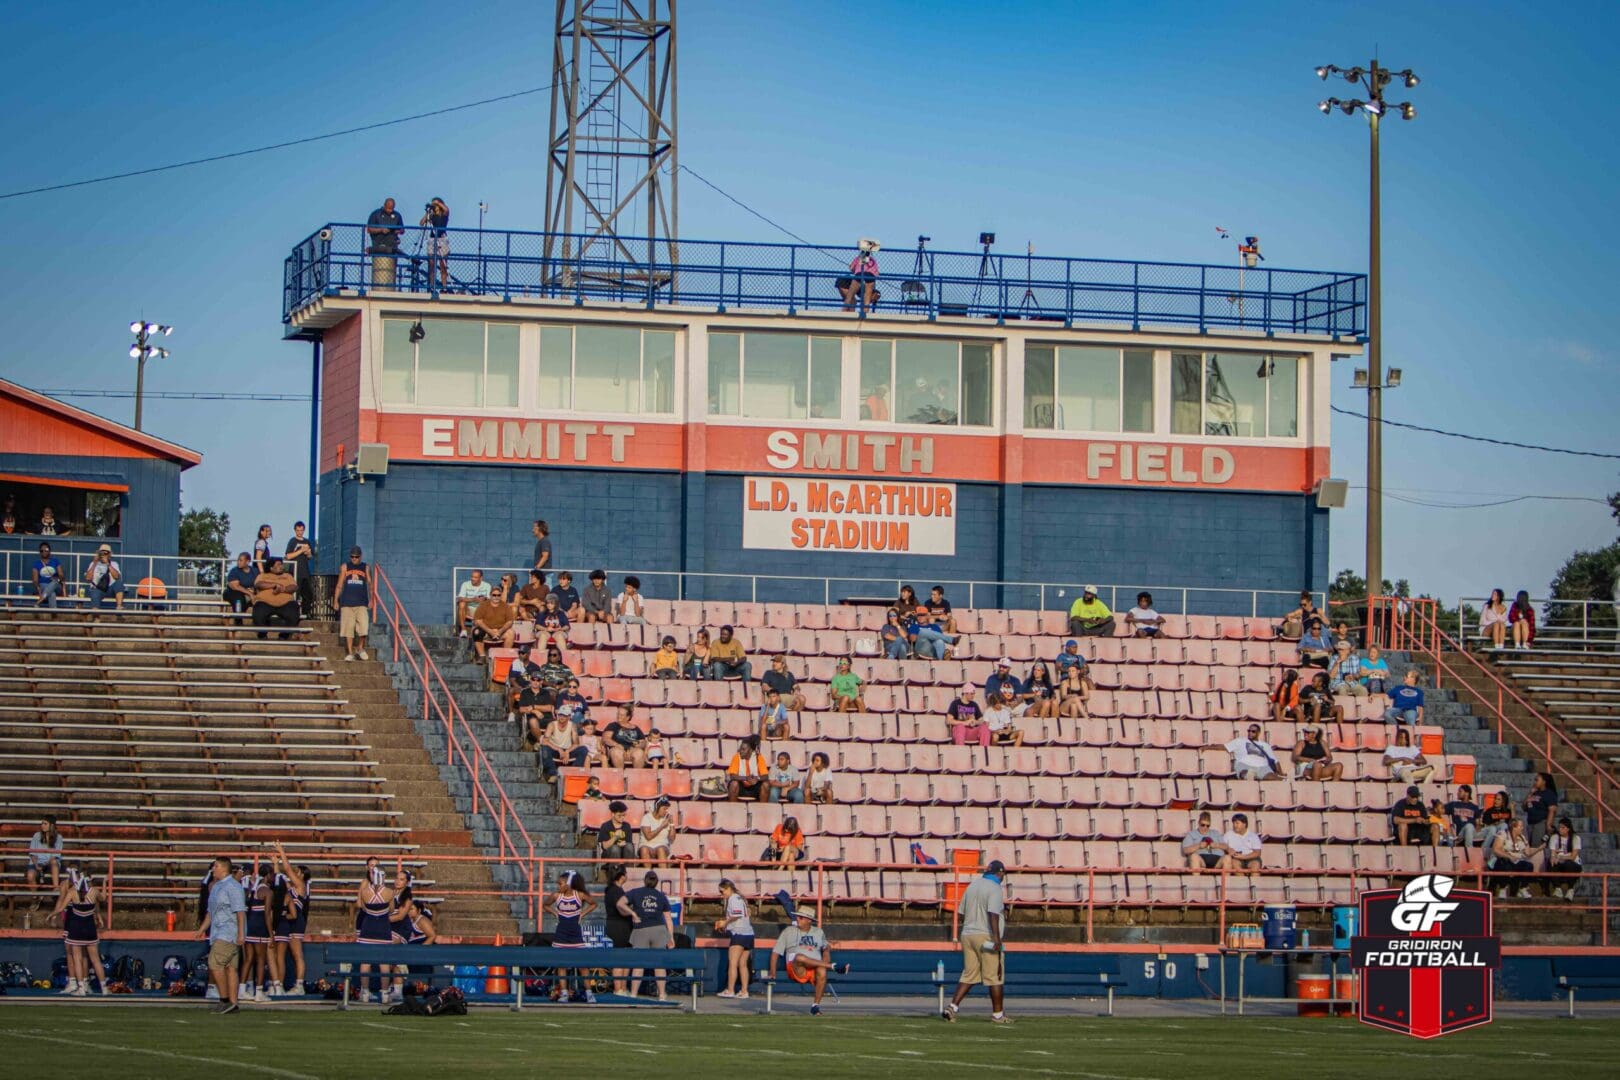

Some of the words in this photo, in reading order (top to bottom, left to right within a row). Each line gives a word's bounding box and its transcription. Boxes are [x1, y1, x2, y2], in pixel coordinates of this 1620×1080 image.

[422, 418, 636, 463] EMMITT
[766, 430, 935, 474] SMITH
[1087, 442, 1236, 484] FIELD
[748, 480, 798, 513] L.D.
[807, 481, 953, 517] McARTHUR
[791, 518, 910, 551] STADIUM
